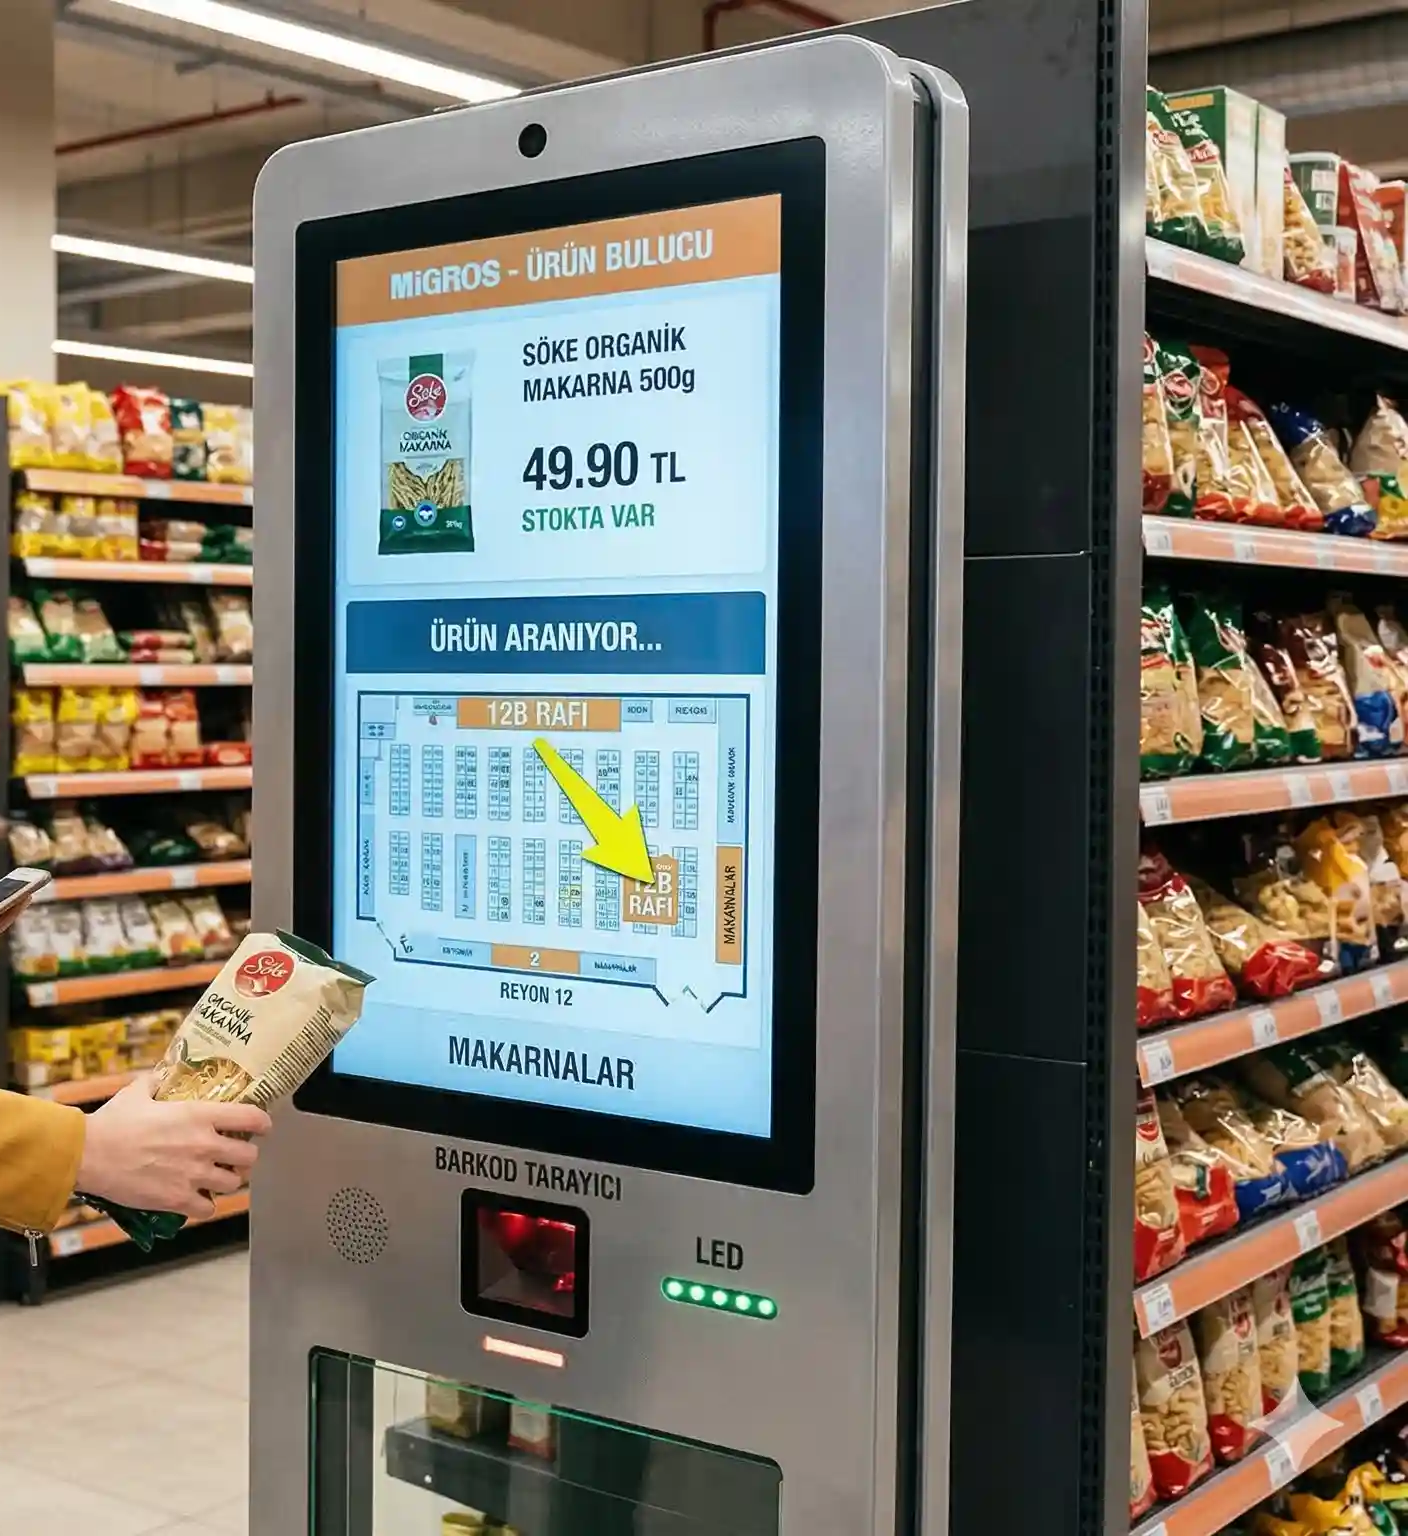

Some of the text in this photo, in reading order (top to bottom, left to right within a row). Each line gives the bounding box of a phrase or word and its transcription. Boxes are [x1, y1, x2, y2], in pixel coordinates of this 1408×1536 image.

[526, 241, 597, 282] ÜRÜN
[605, 228, 714, 270] BULUCU
[522, 323, 687, 367] SÖKE ORGANİK
[523, 366, 696, 403] MAKARNA 500g
[522, 441, 686, 491] 49.90 TL
[522, 503, 655, 532] STOKTA VAR
[430, 618, 662, 653] ÜRÜN ARANIYOR...
[487, 699, 588, 727] 12B RAFI
[629, 893, 673, 918] RAFI
[529, 952, 540, 967] 2
[500, 981, 573, 1006] REYON 12
[448, 1035, 635, 1091] MAKARNALAR
[434, 1146, 623, 1202] BARKOD TARAYICI
[695, 1236, 744, 1271] LED
